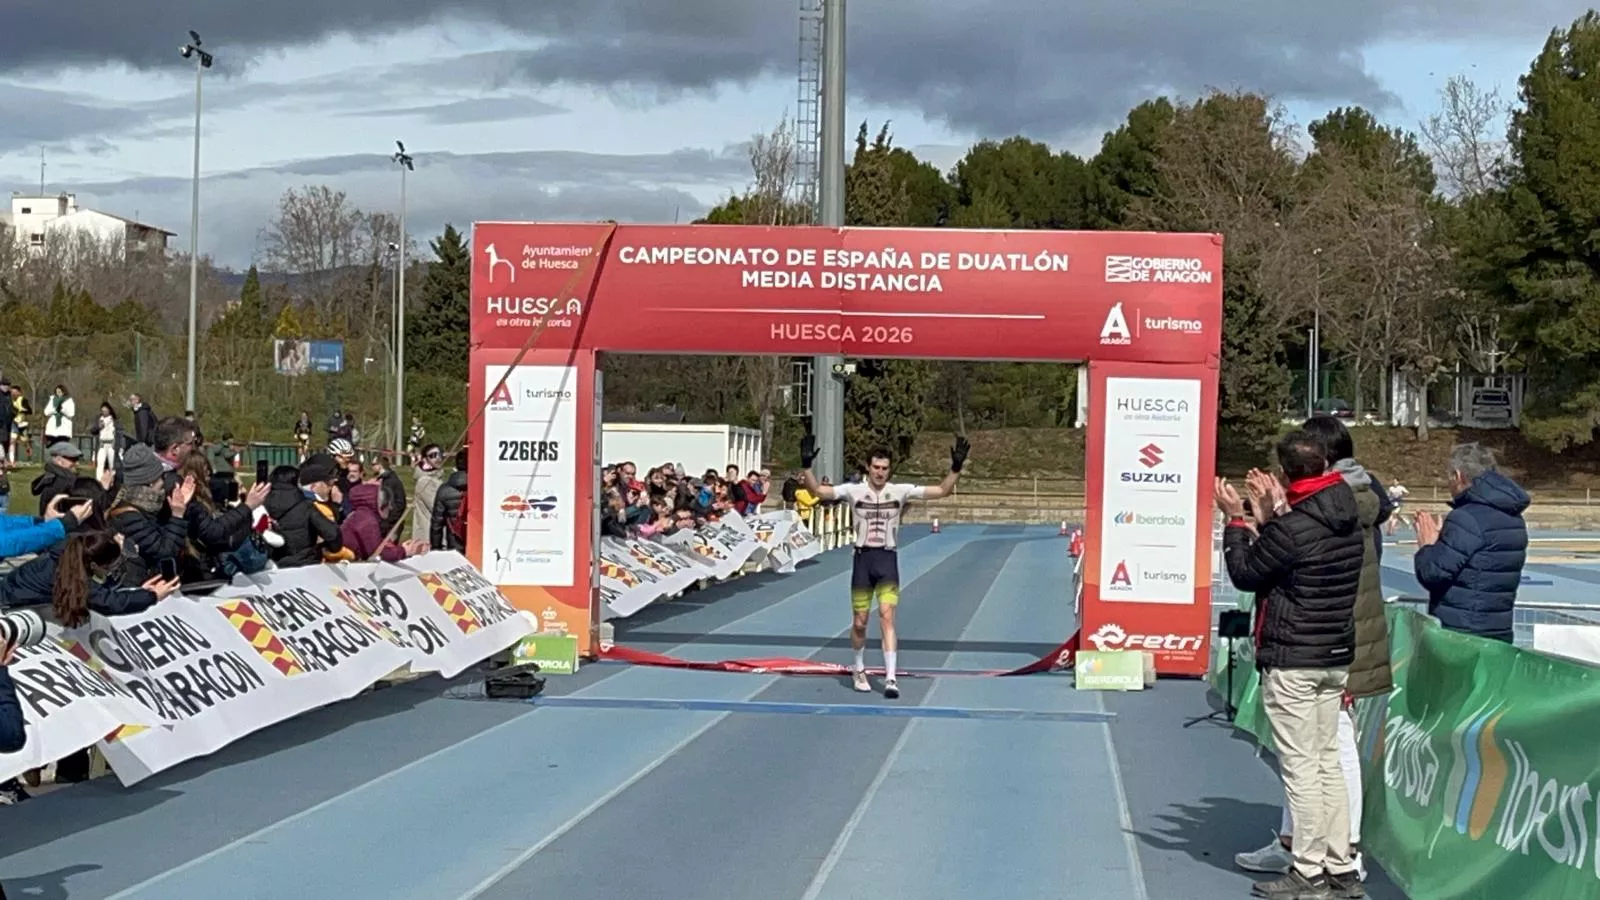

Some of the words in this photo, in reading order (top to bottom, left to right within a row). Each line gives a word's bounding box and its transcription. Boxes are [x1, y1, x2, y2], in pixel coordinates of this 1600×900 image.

[521, 258, 537, 269] de
[539, 258, 579, 269] Huesca
[618, 246, 780, 265] CAMPEONATO
[786, 249, 817, 266] DE
[823, 248, 914, 269] ESPAÑA
[920, 252, 951, 270] DE
[957, 250, 1069, 272] DUATLÓN
[1132, 257, 1202, 271] GOBIERNO
[742, 271, 815, 289] MEDIA
[820, 272, 943, 292] DISTANCIA
[1132, 270, 1150, 281] DE
[1144, 316, 1203, 330] turismo
[770, 323, 856, 342] HUESCA
[861, 326, 914, 343] 2026
[526, 388, 572, 398] turismo
[1117, 397, 1189, 413] HUESCA
[498, 440, 559, 461] 226ERS
[1120, 472, 1182, 484] SUZUKI
[1143, 571, 1187, 581] turismo
